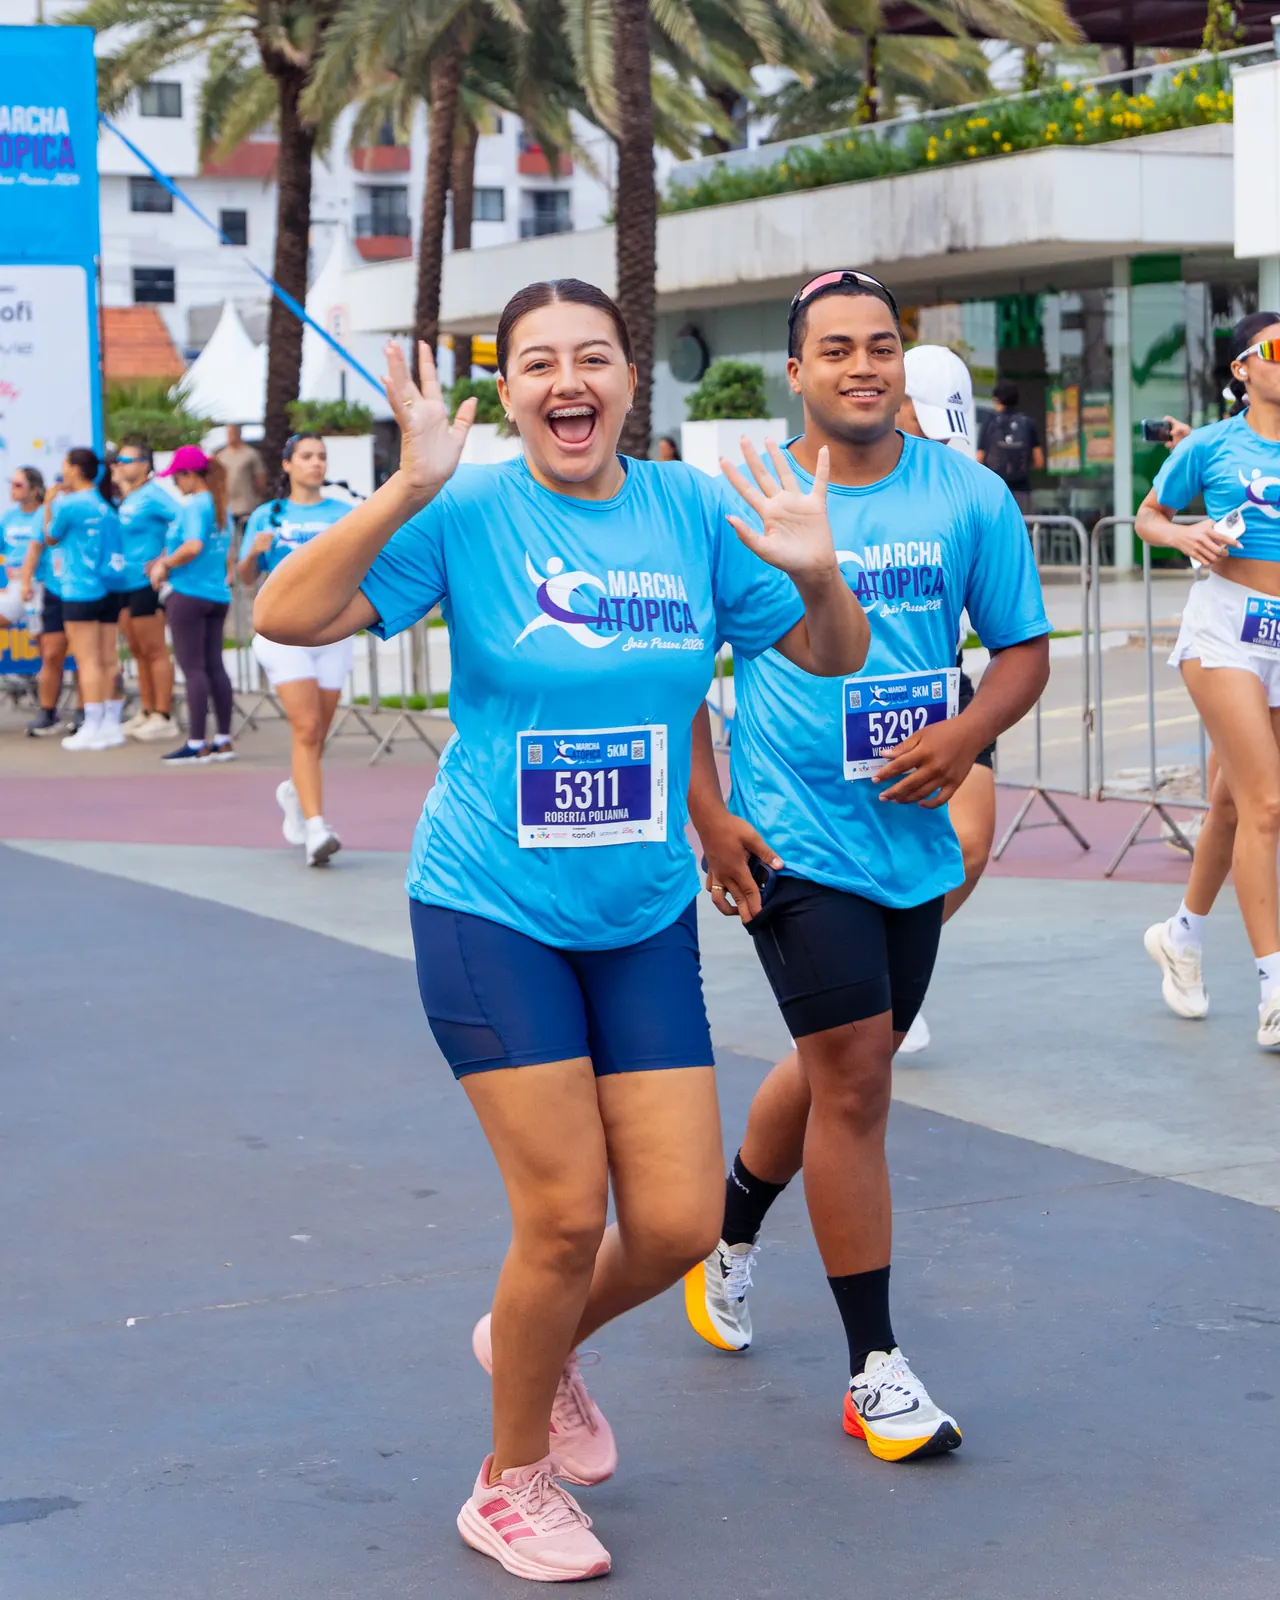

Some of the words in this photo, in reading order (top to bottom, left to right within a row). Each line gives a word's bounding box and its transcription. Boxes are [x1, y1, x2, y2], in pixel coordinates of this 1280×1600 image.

[0, 105, 70, 135] ARCHA
[0, 131, 75, 169] ÓPICA
[0, 302, 32, 321] ofi
[863, 541, 943, 570] MARCHA
[607, 570, 688, 602] MARCHA
[856, 562, 944, 601] ATÓPICA
[596, 591, 699, 635] ATÓPICA
[900, 601, 926, 613] Pessoa
[622, 636, 648, 651] João
[650, 638, 681, 650] Pessoa
[681, 638, 705, 650] 2026
[911, 685, 929, 699] 5KM
[868, 707, 928, 746] 5292
[575, 742, 600, 751] MARCHA
[607, 743, 628, 758] 5KM
[554, 769, 619, 810] 5311
[544, 811, 586, 823] ROBERTA
[588, 808, 629, 822] POLIANNA
[571, 831, 596, 839] sanofi
